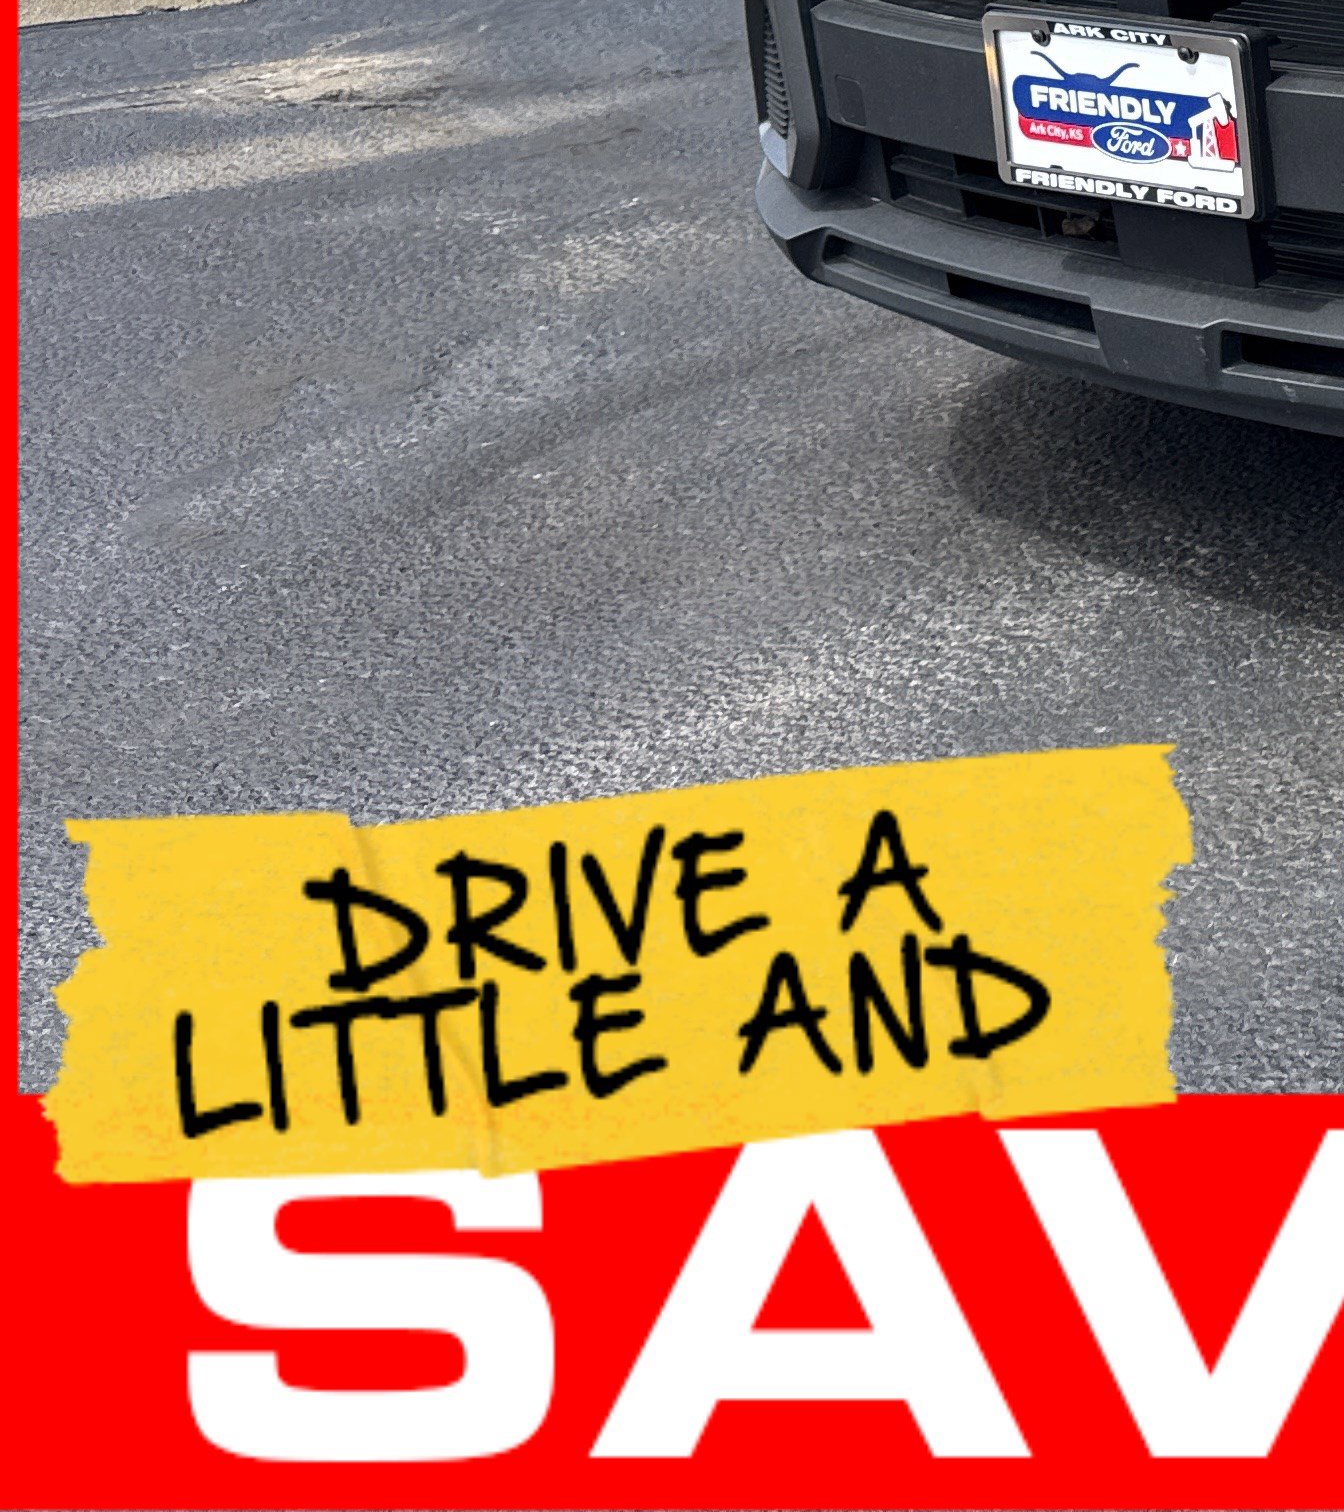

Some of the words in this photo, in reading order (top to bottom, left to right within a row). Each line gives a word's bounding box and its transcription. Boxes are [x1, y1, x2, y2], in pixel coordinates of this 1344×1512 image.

[1052, 22, 1105, 40] ARK
[1110, 28, 1168, 47] CITY
[1030, 85, 1176, 125] FRIENDLY
[1029, 124, 1046, 136] Ark
[1047, 125, 1069, 140] City,
[1069, 128, 1084, 141] KS
[1106, 126, 1155, 158] Ford
[1015, 169, 1151, 201] FRIENDLY
[1157, 189, 1239, 214] FORD
